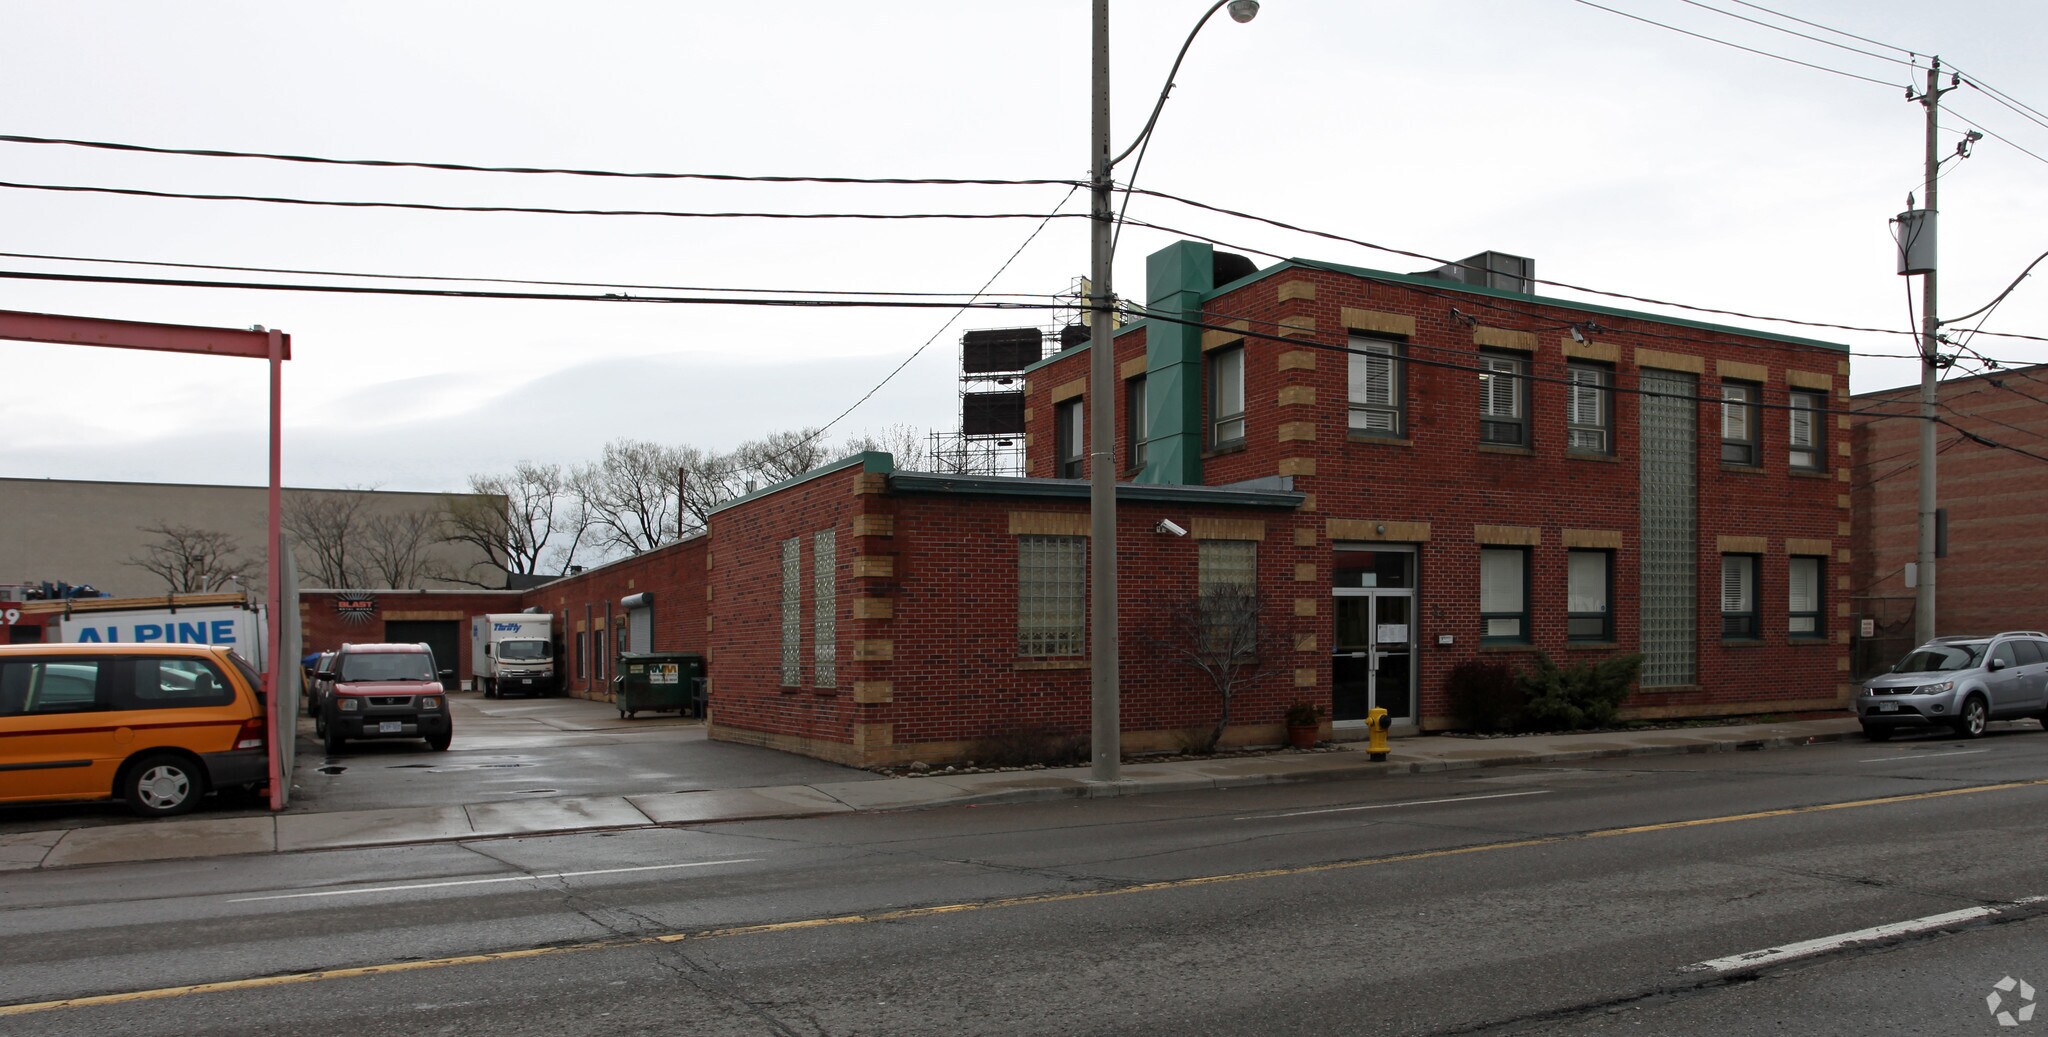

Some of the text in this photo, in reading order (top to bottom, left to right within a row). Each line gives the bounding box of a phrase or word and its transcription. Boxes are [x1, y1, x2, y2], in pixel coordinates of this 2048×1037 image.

[0, 608, 20, 625] 9
[78, 620, 236, 644] ALPINE
[493, 623, 522, 634] Thrifty
